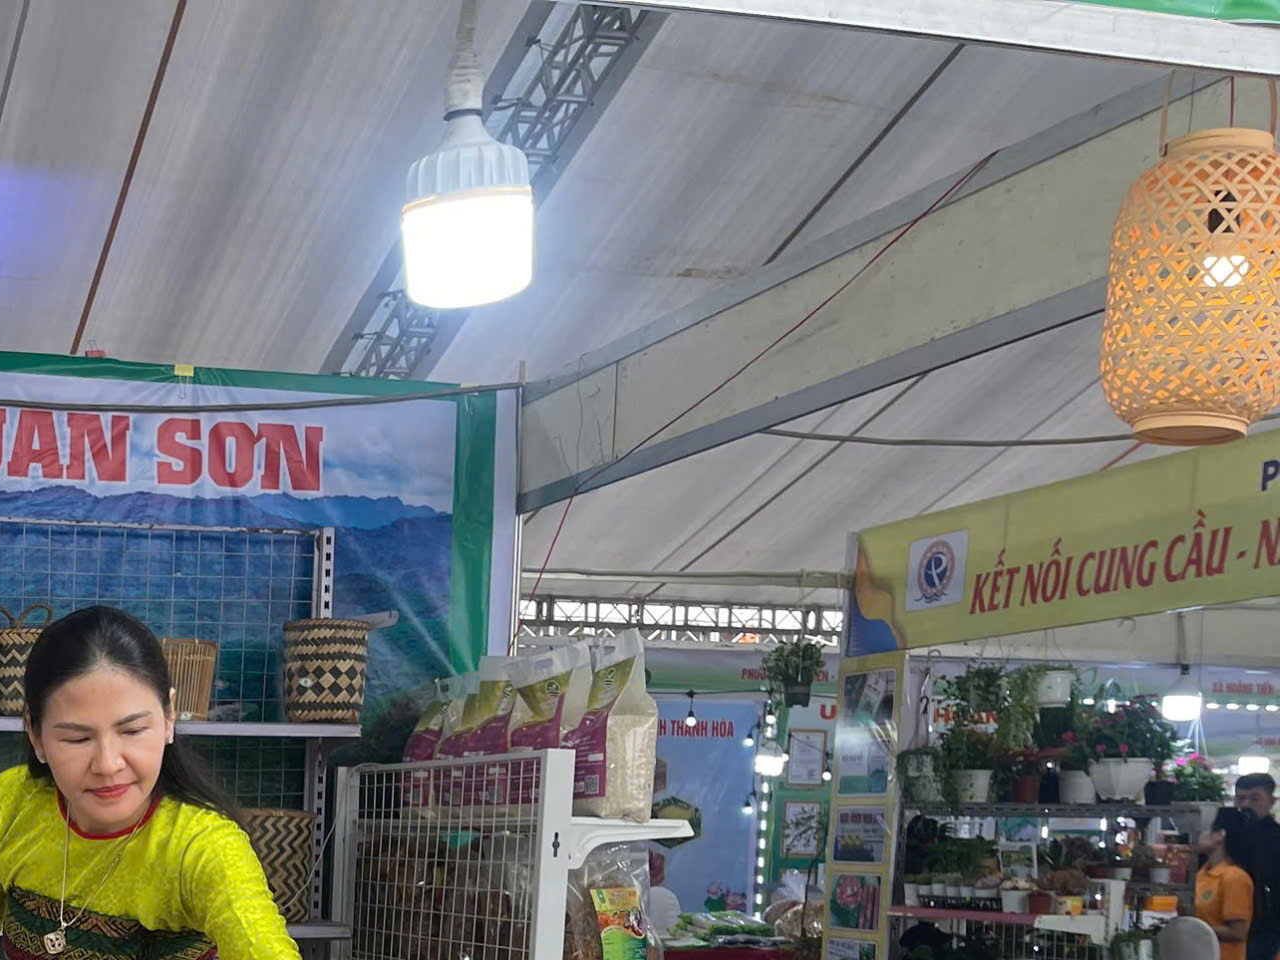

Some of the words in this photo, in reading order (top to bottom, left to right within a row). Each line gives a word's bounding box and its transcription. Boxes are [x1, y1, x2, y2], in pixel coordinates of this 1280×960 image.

[156, 417, 323, 492] SƠN
[969, 548, 1021, 614] KẾT
[1020, 537, 1074, 607] NỐI
[1076, 539, 1159, 597] CUNG
[1164, 508, 1233, 582] CẦU
